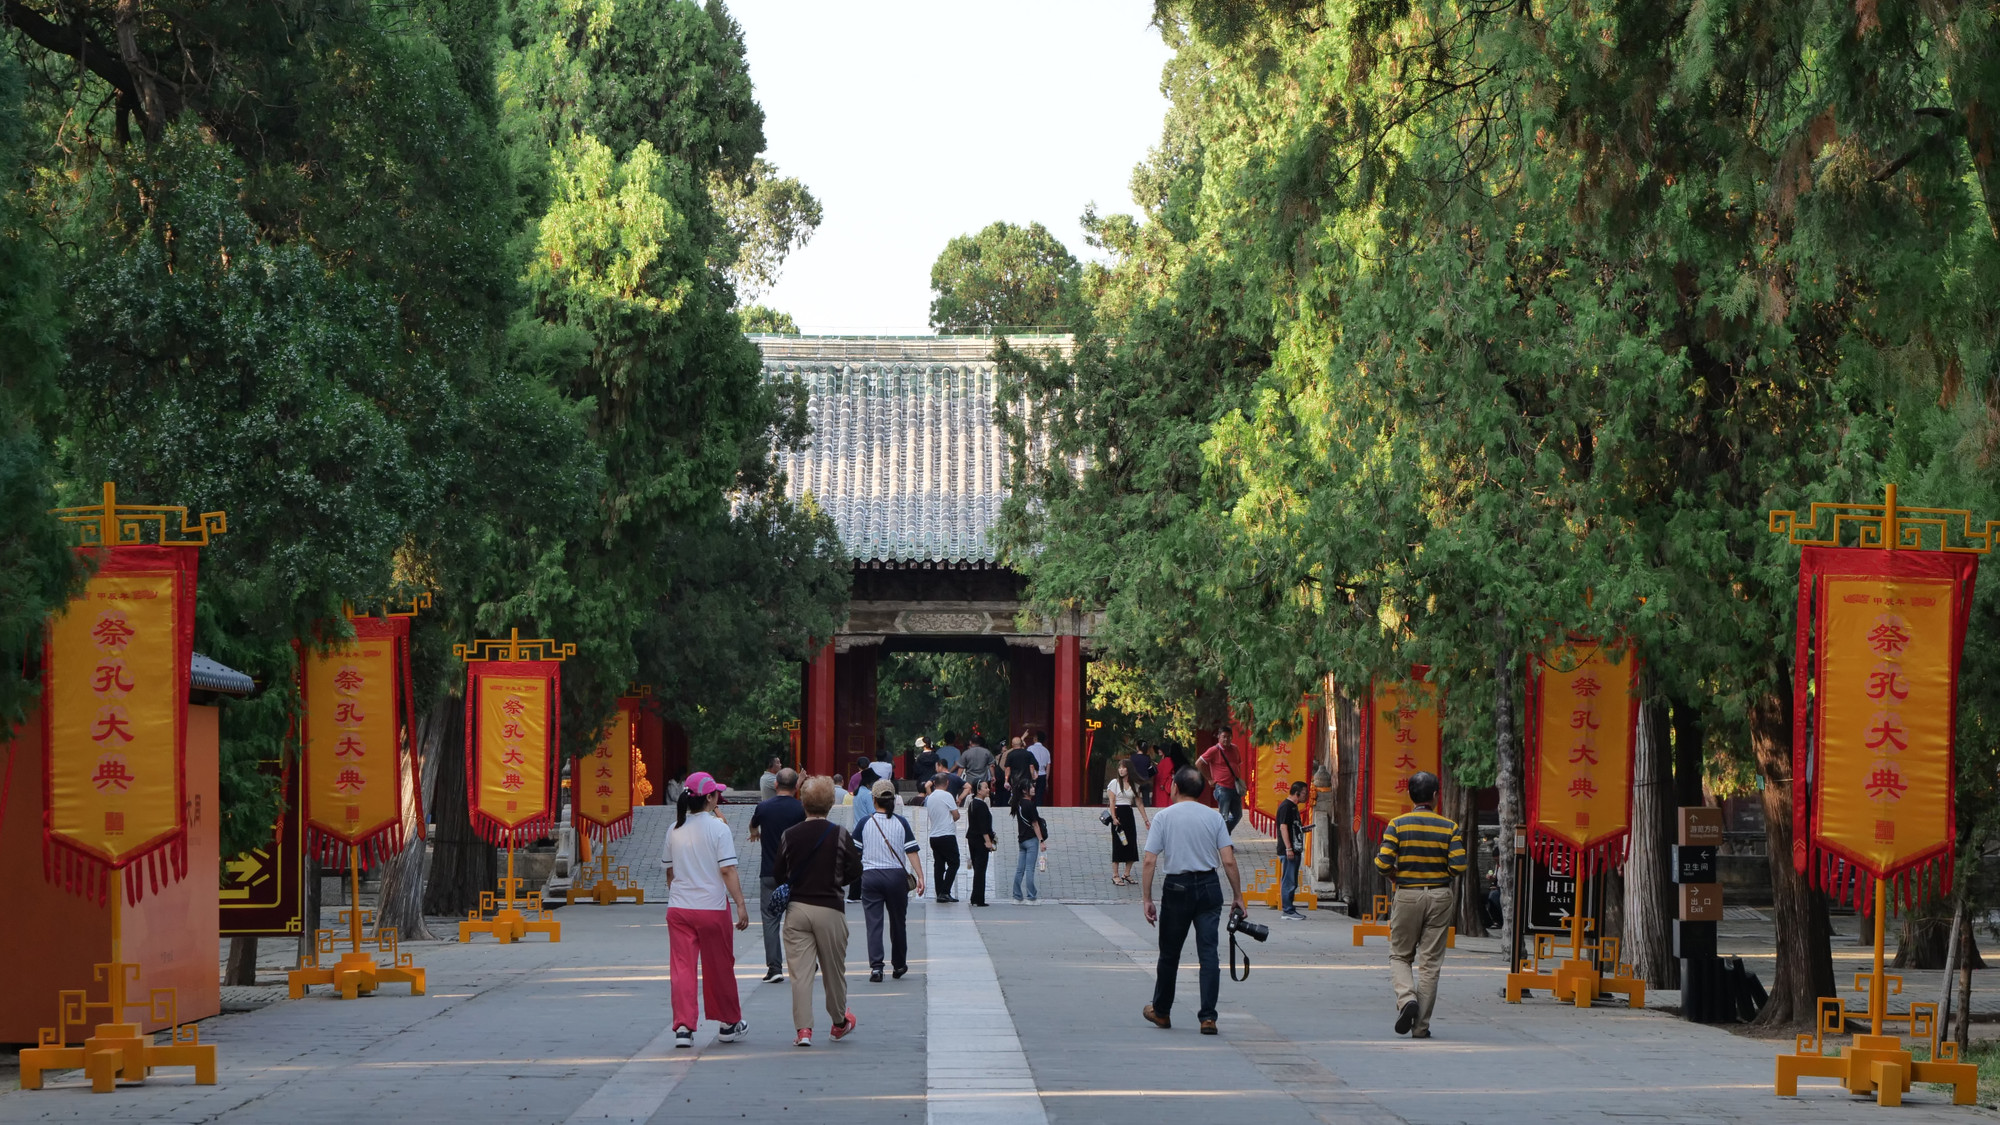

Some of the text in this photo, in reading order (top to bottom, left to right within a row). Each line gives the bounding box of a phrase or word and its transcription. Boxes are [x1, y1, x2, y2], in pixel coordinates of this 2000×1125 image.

[92, 617, 135, 791] 祭孔大典
[334, 670, 366, 791] 祭孔大典
[502, 699, 525, 789] 祭孔大典
[1567, 676, 1602, 799] 祭孔大典
[1865, 623, 1910, 799] 祭孔大典
[1550, 895, 1571, 904] Exit
[1683, 863, 1709, 871] 卫生间
